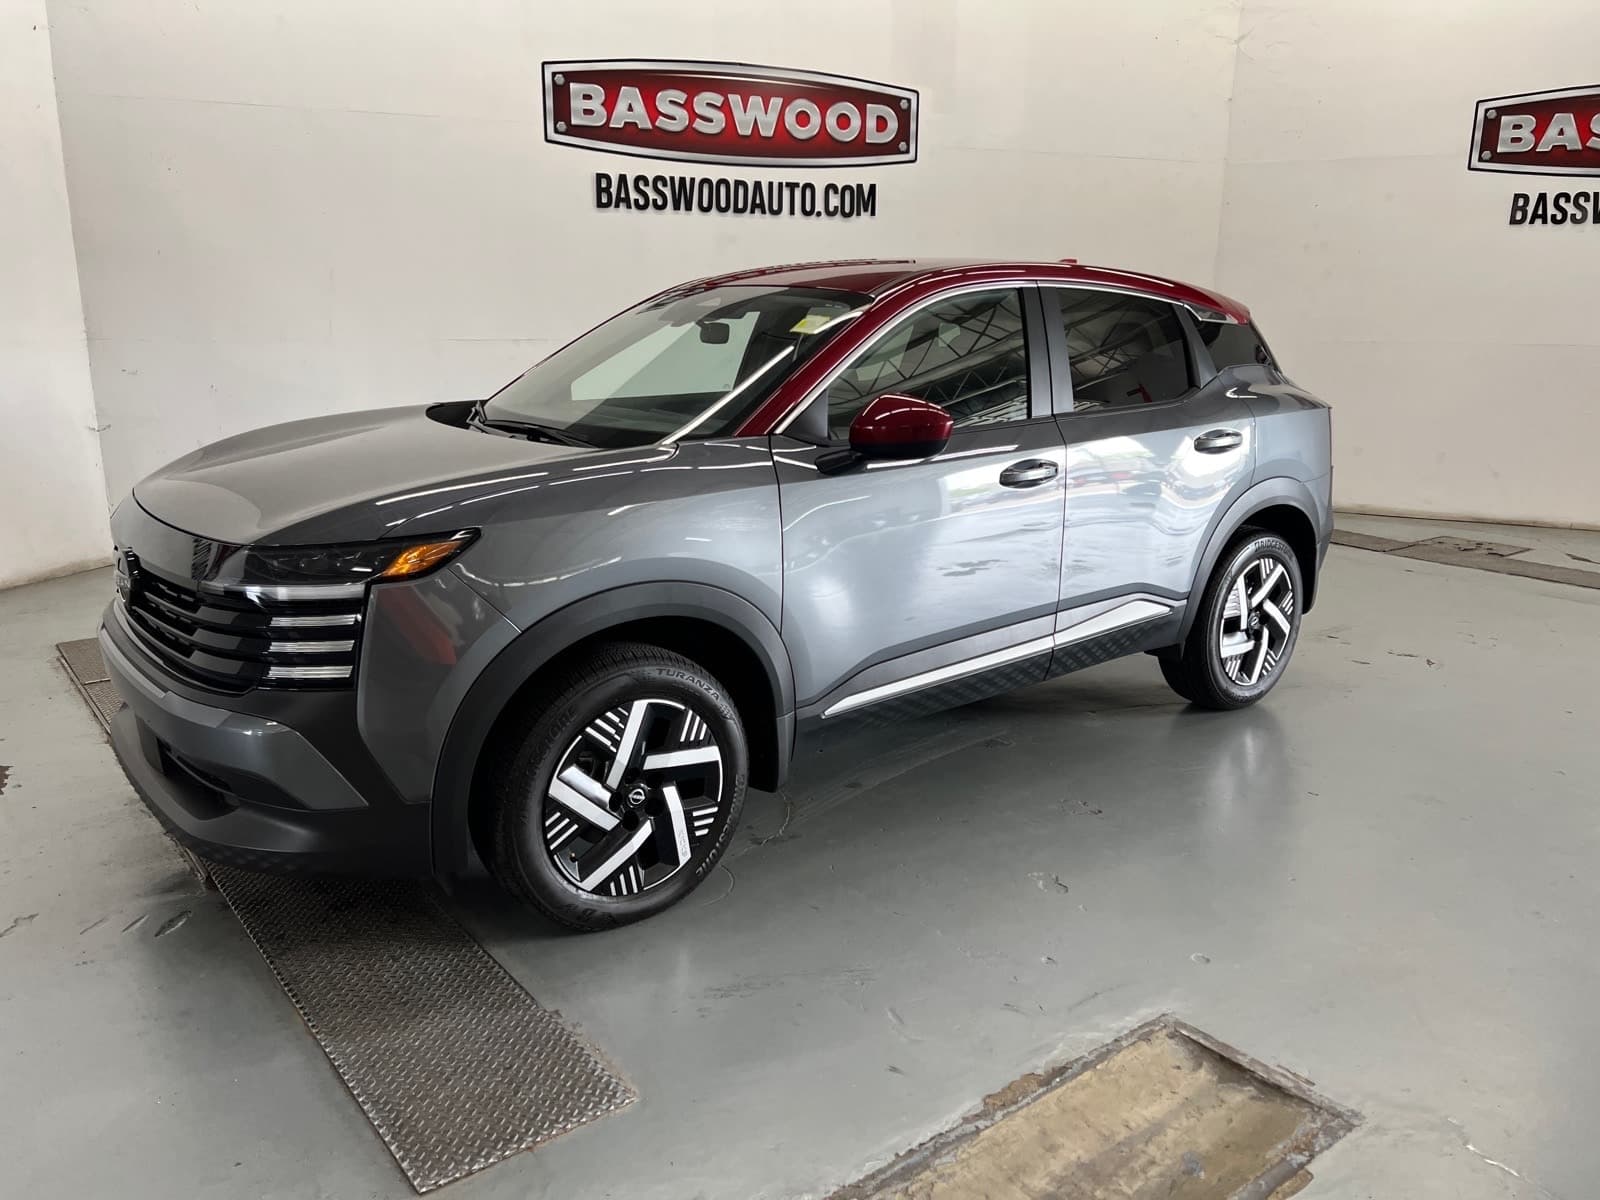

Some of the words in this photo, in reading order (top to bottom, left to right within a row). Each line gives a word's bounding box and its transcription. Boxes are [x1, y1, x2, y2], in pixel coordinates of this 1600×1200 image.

[569, 82, 899, 144] BASSWOOD
[595, 172, 877, 218] BASSWOODAUTO.COM
[1509, 191, 1600, 225] BASS
[656, 667, 721, 701] TURANZA
